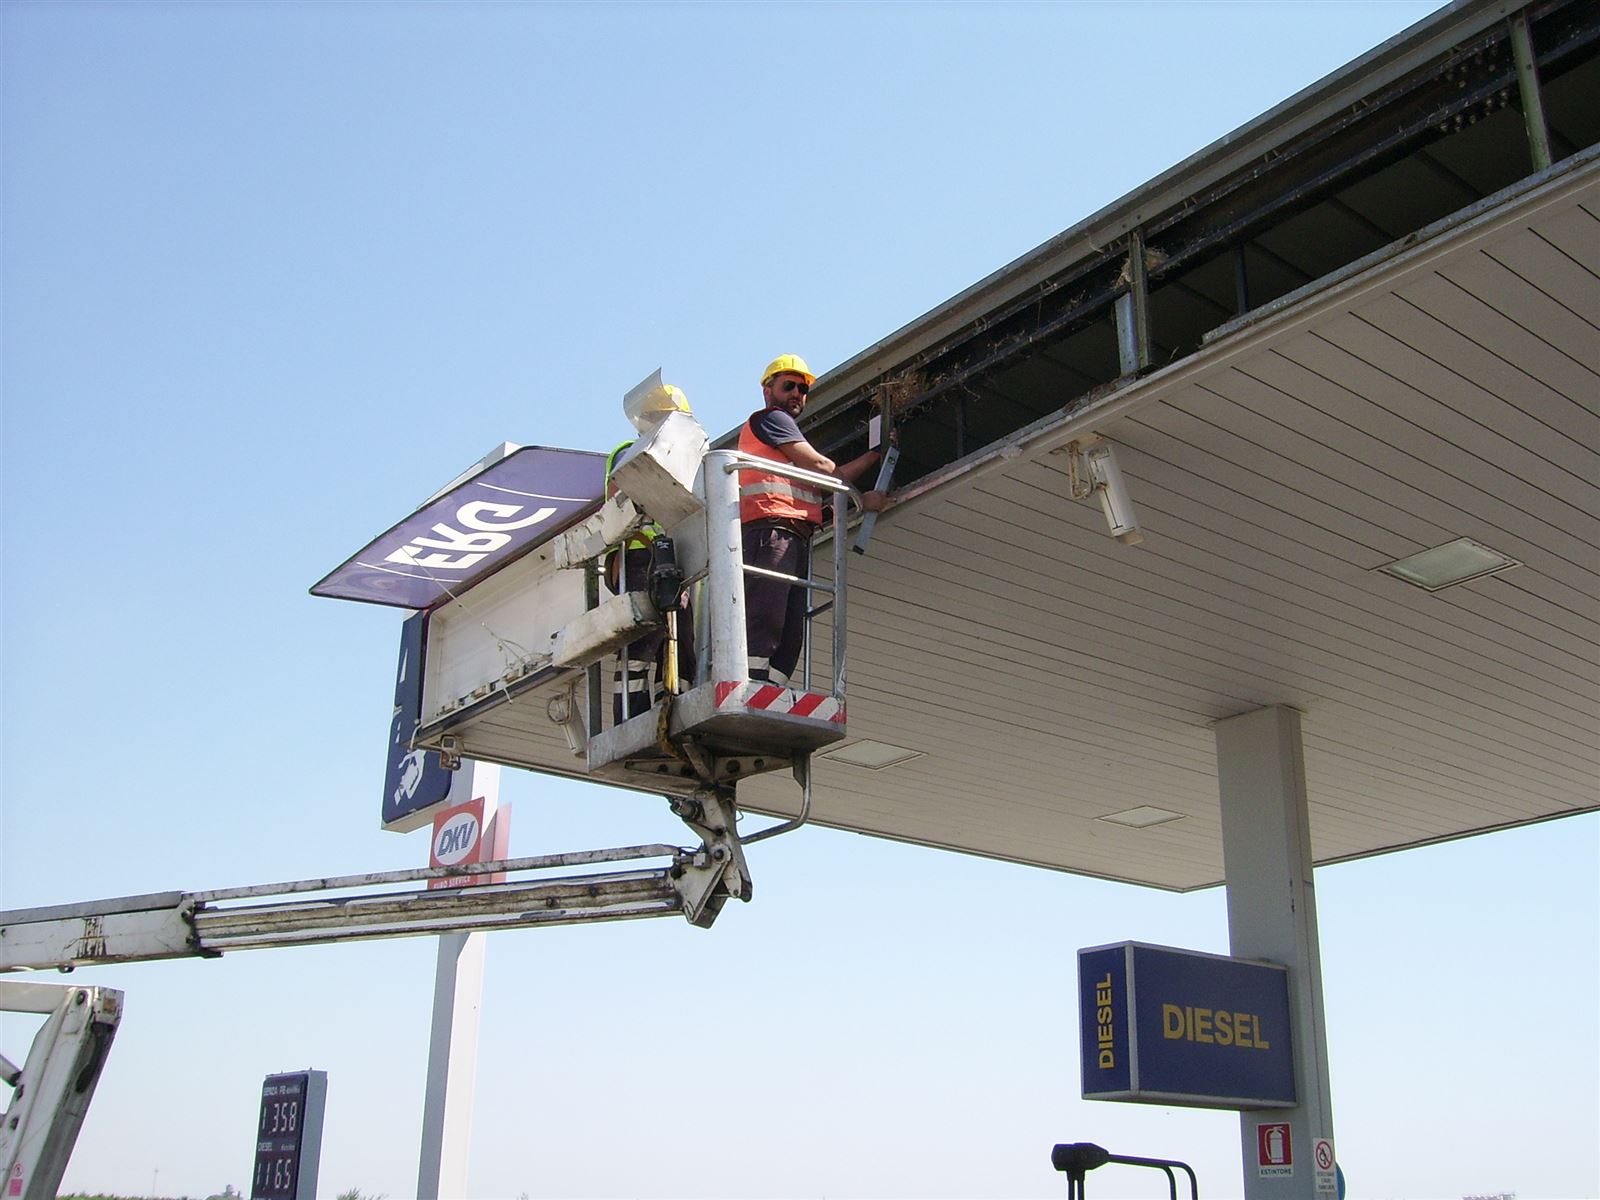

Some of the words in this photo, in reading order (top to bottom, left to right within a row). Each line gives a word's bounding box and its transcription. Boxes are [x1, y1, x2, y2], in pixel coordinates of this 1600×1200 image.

[437, 820, 475, 857] DKV
[1096, 972, 1116, 1070] DIESEL
[1162, 1003, 1270, 1050] DIESEL
[1260, 1168, 1292, 1176] ESTINTORE
